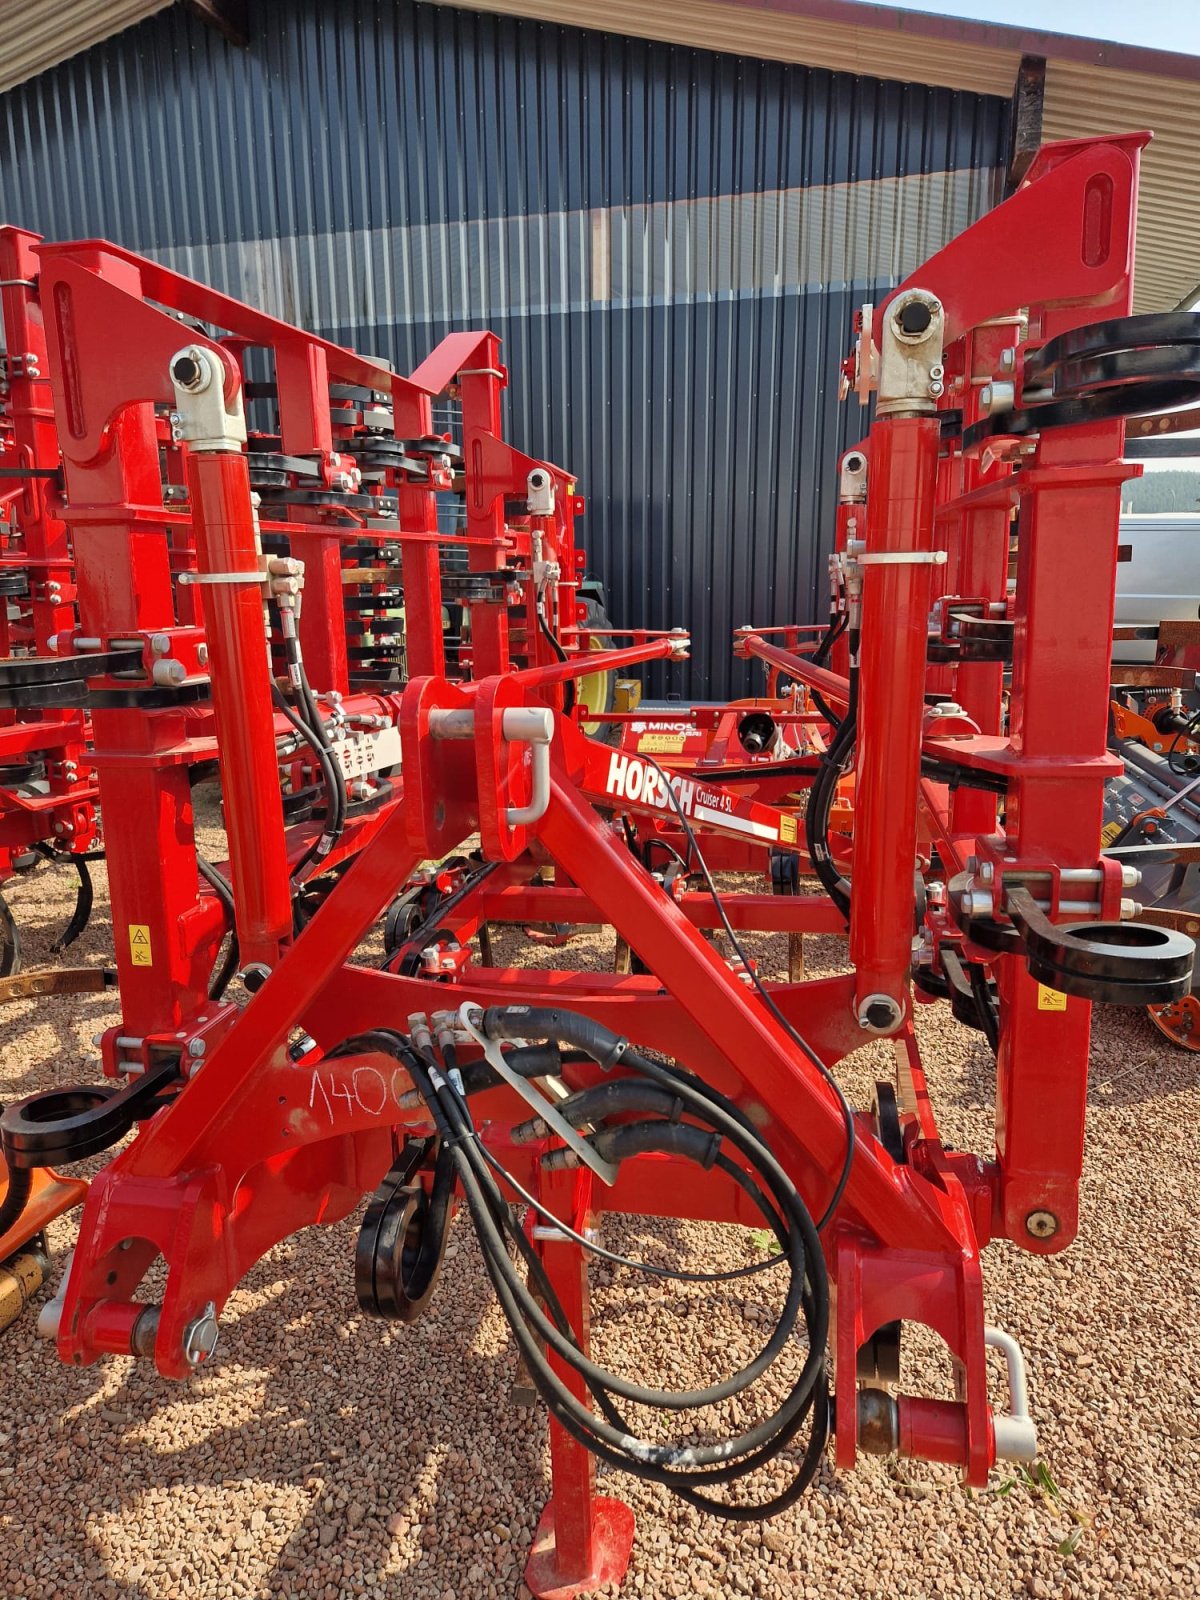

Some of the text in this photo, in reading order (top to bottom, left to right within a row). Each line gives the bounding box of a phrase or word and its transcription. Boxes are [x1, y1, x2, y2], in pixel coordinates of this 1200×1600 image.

[648, 722, 697, 731] MINOS
[606, 752, 694, 815] HORSCH
[696, 786, 720, 808] Cruiser
